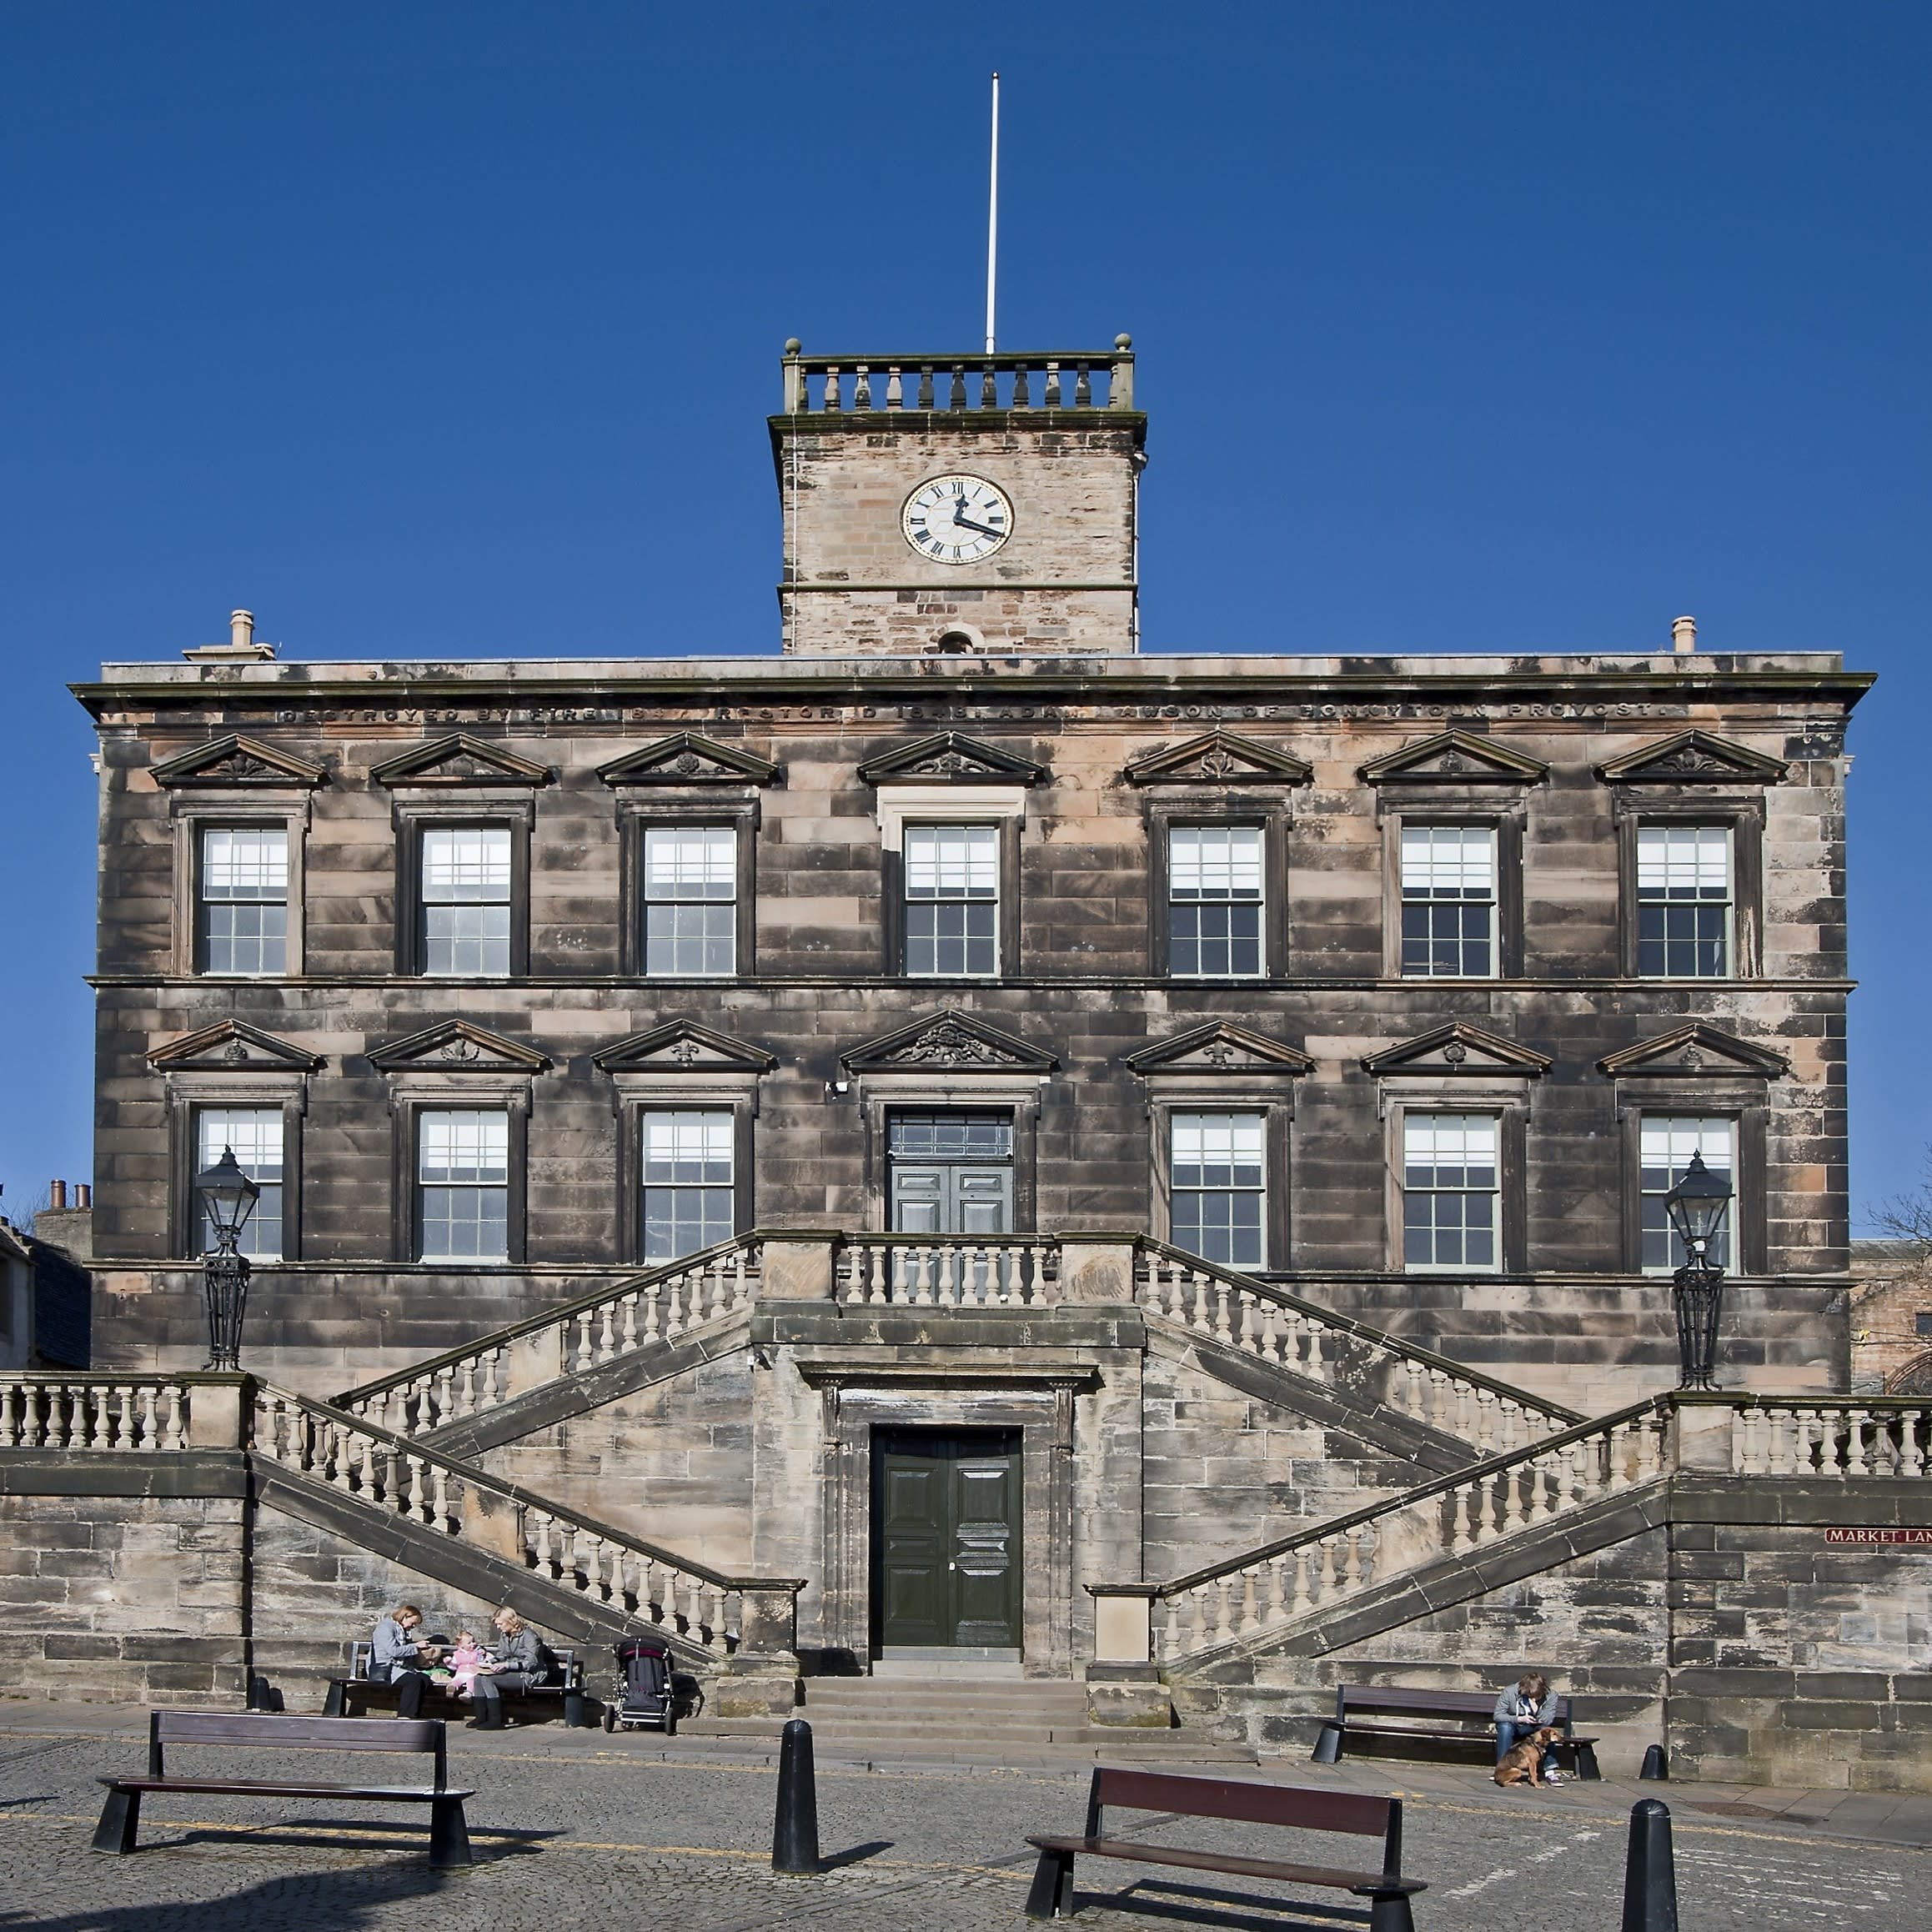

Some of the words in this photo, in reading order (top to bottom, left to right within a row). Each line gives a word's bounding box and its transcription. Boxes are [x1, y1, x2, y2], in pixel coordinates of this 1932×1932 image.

[952, 482, 963, 494] XII
[283, 709, 458, 722] DESTROYED
[478, 708, 509, 720] BY
[529, 707, 596, 720] FIRE
[1243, 705, 1279, 718] OF
[1830, 1529, 1899, 1542] MARKET
